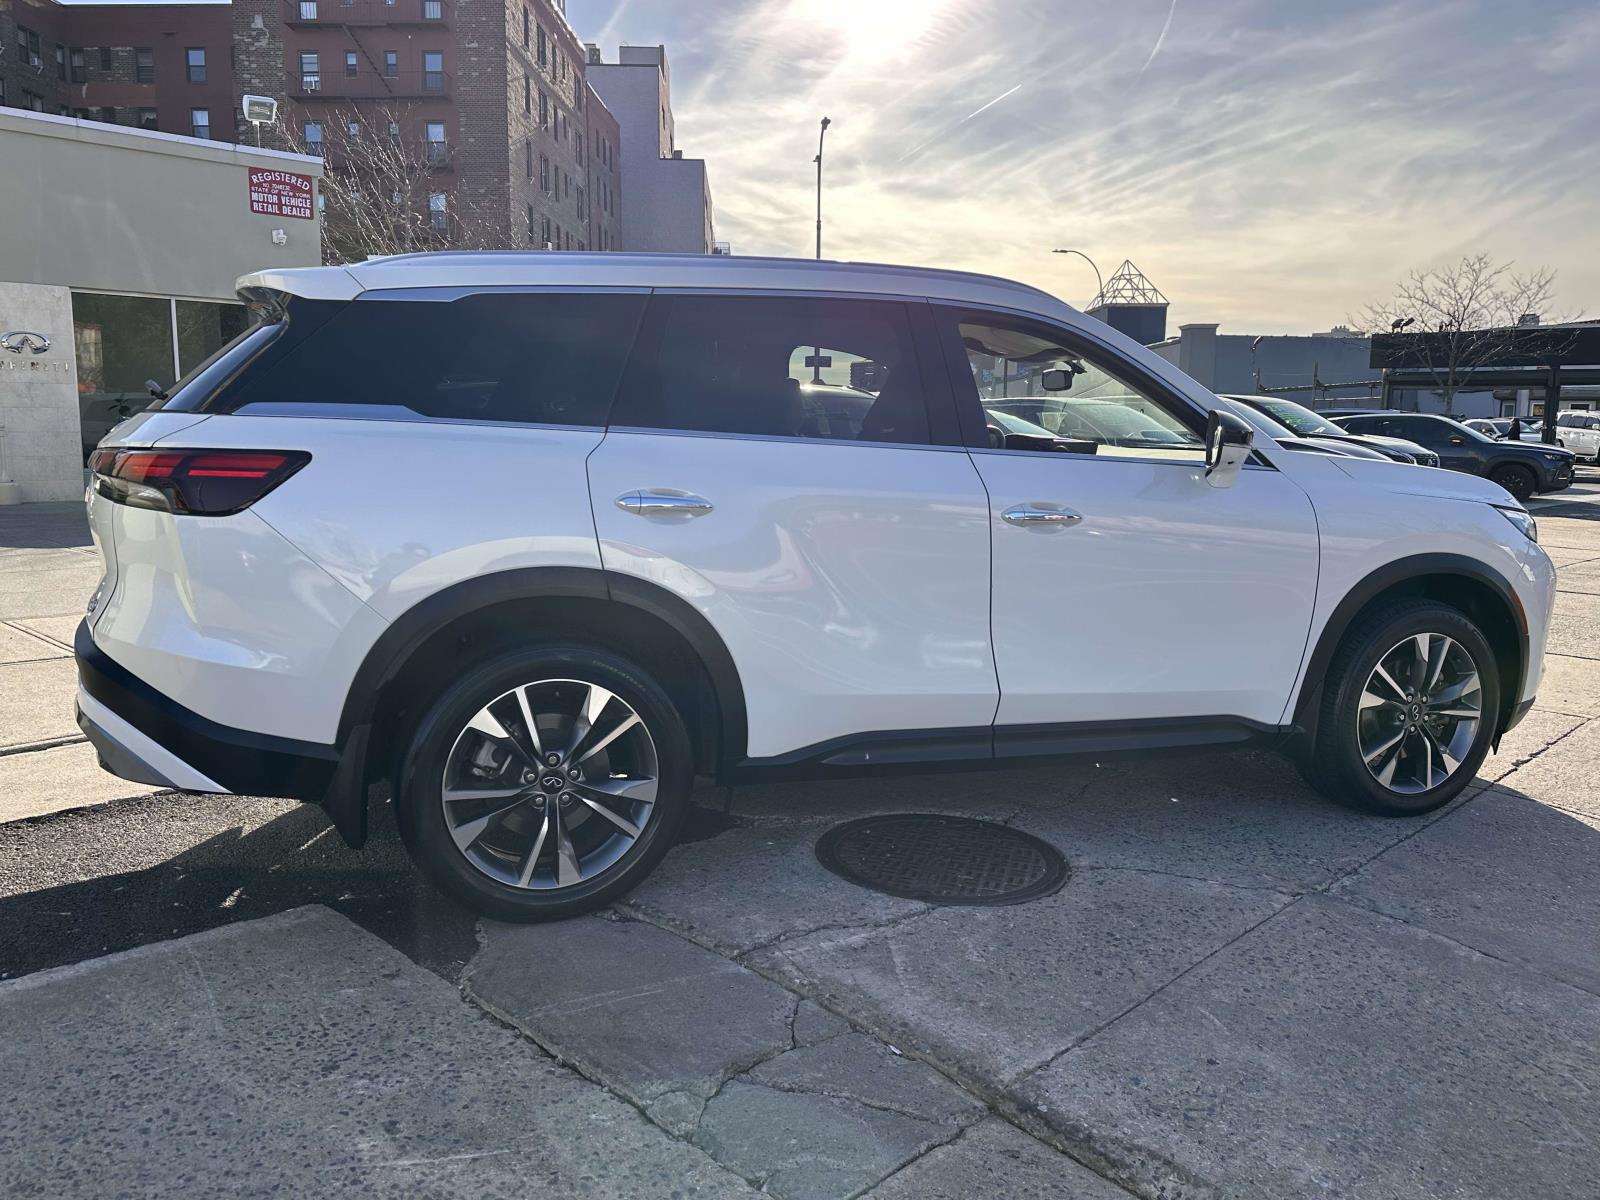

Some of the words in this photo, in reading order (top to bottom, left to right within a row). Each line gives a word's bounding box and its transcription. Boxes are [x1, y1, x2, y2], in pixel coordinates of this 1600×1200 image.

[251, 172, 310, 190] REGISTERED
[251, 192, 278, 204] MOTOR
[281, 196, 311, 208] VEHICLE
[253, 202, 280, 214] RETAIL
[282, 206, 311, 218] DEALER
